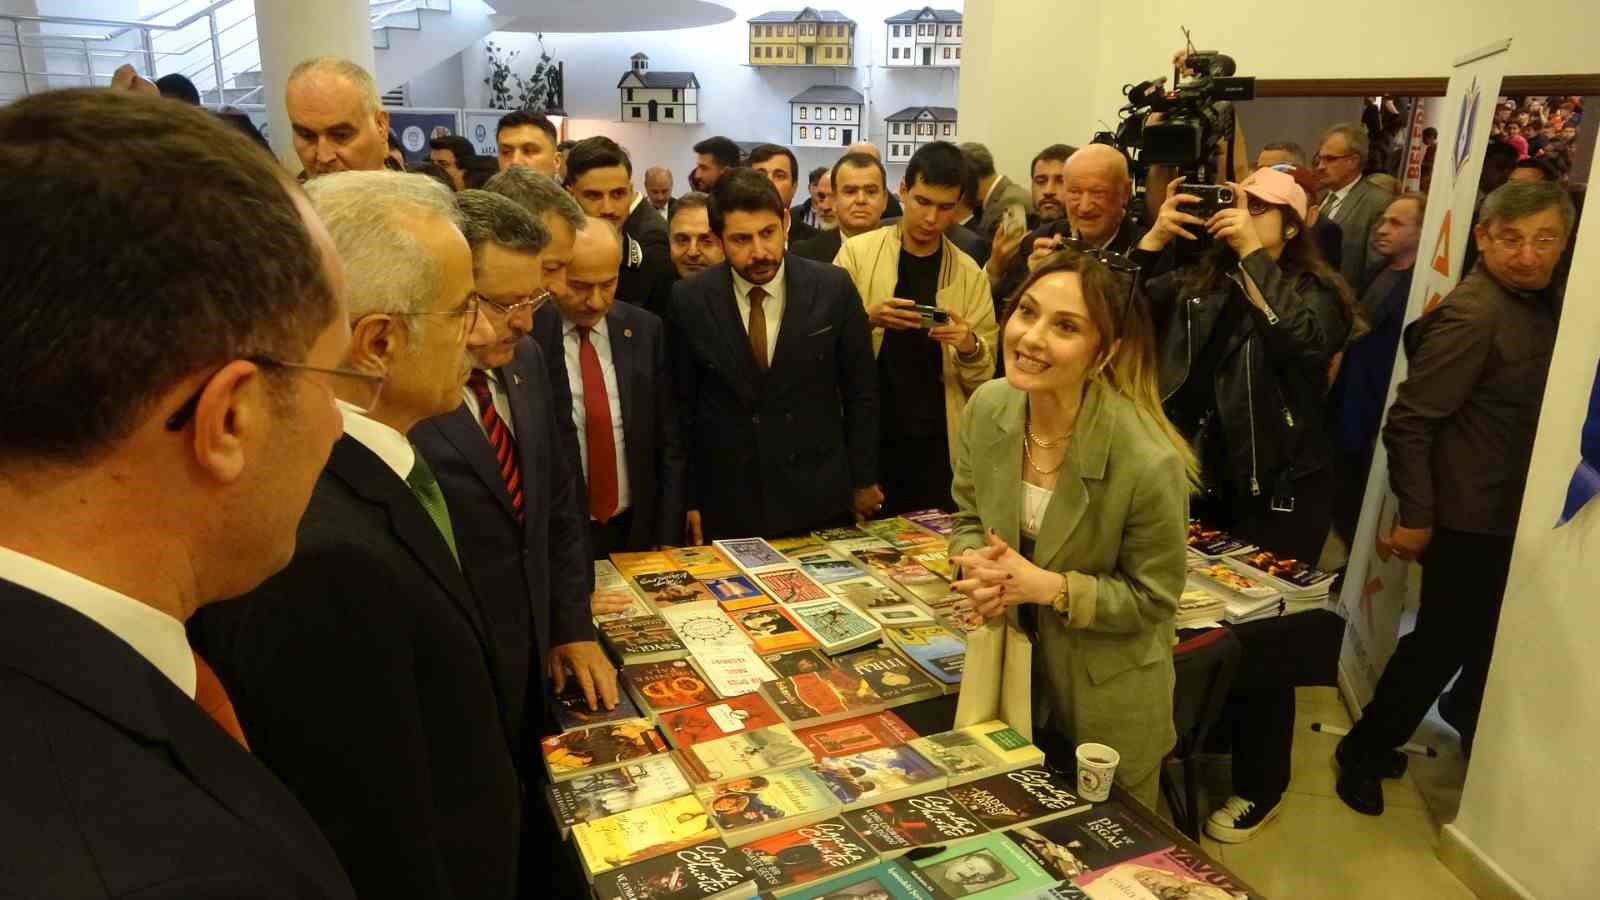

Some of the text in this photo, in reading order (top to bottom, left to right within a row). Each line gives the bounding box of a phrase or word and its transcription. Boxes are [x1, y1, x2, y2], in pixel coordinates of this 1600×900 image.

[1007, 773, 1067, 809] Christie
[1021, 769, 1077, 806] Agatha
[908, 798, 967, 837] Christie
[924, 795, 977, 833] Agatha
[797, 828, 851, 867] Christie
[815, 823, 866, 864] Agatha
[676, 850, 726, 893] Christie
[695, 845, 744, 886] Agatha
